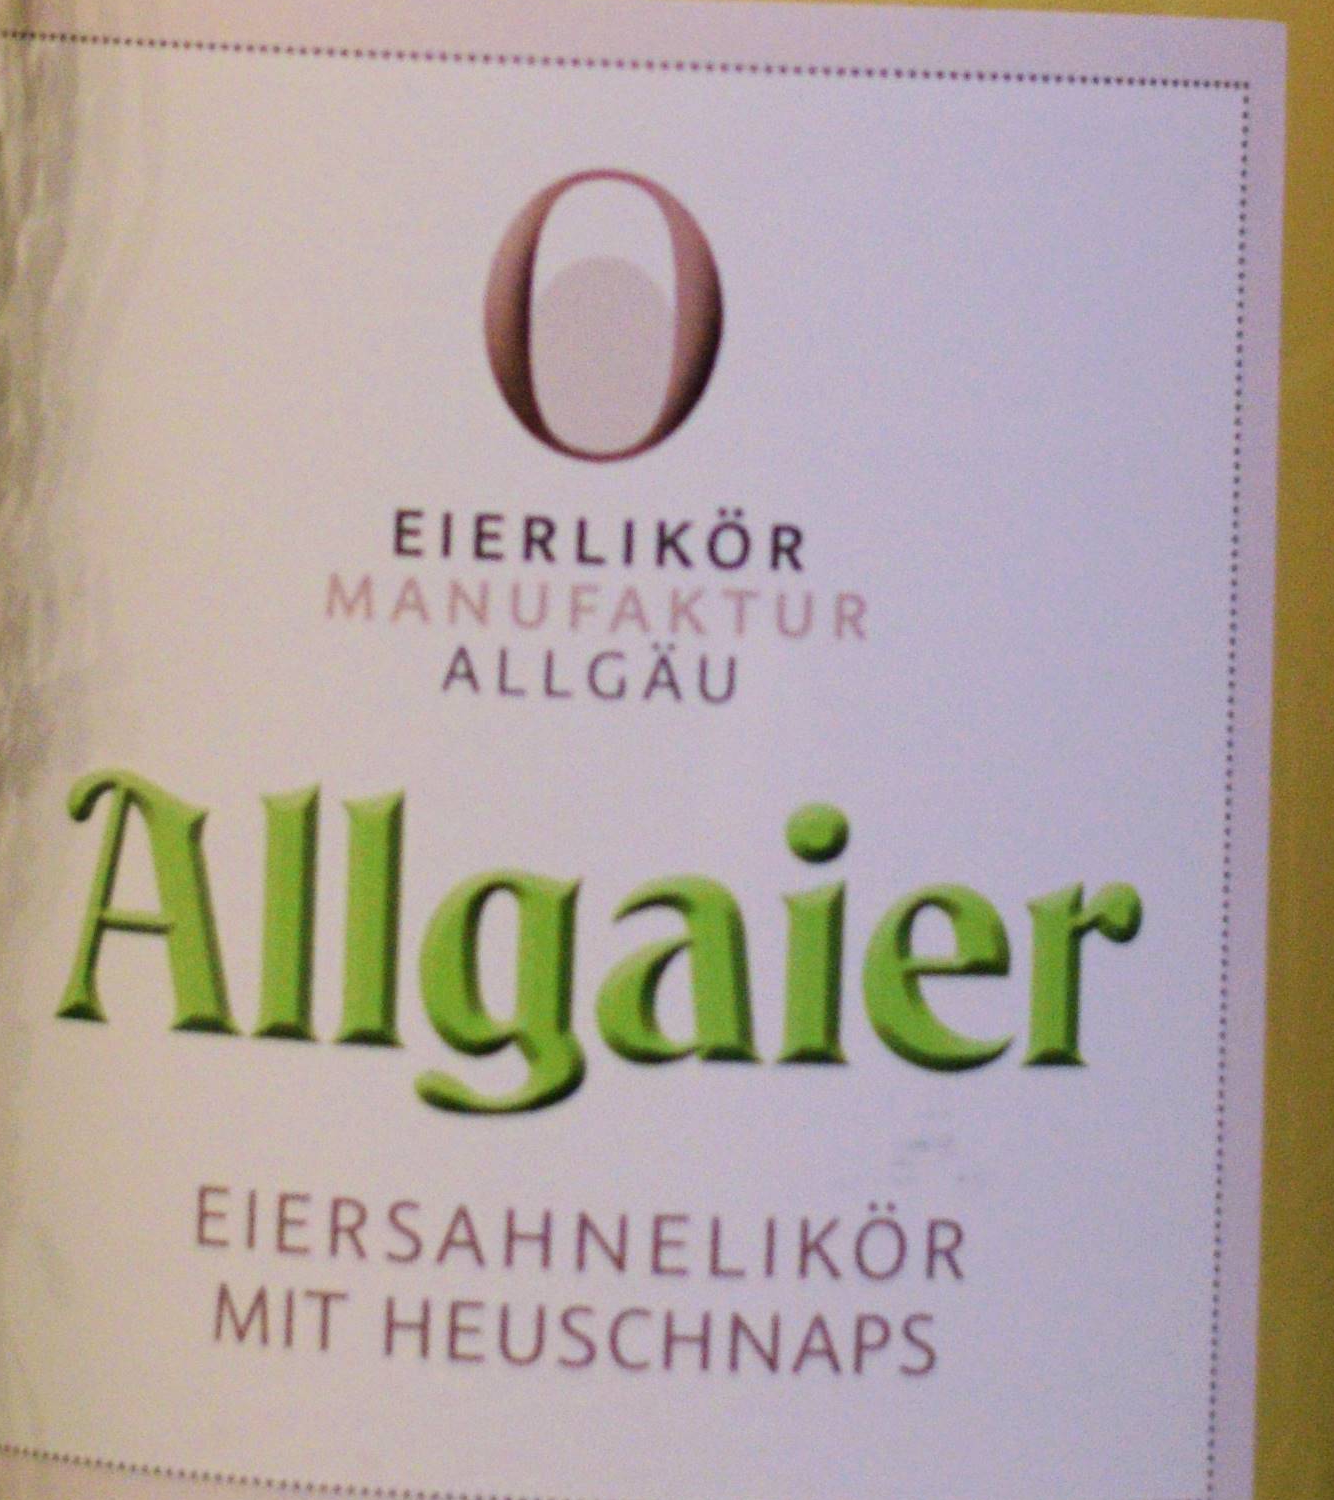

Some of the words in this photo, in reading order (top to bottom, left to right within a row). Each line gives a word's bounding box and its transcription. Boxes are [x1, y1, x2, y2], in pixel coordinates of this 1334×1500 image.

[392, 508, 807, 571] EIERLIKÖR
[325, 574, 870, 640] MANUFAKTUR
[442, 645, 739, 705] ALLGÄU
[56, 770, 1143, 1113] Allgaier
[195, 1185, 967, 1282] EIERSAHNELIKÖR
[213, 1284, 348, 1355] MIT
[383, 1296, 939, 1377] HEUSCHNAPS
